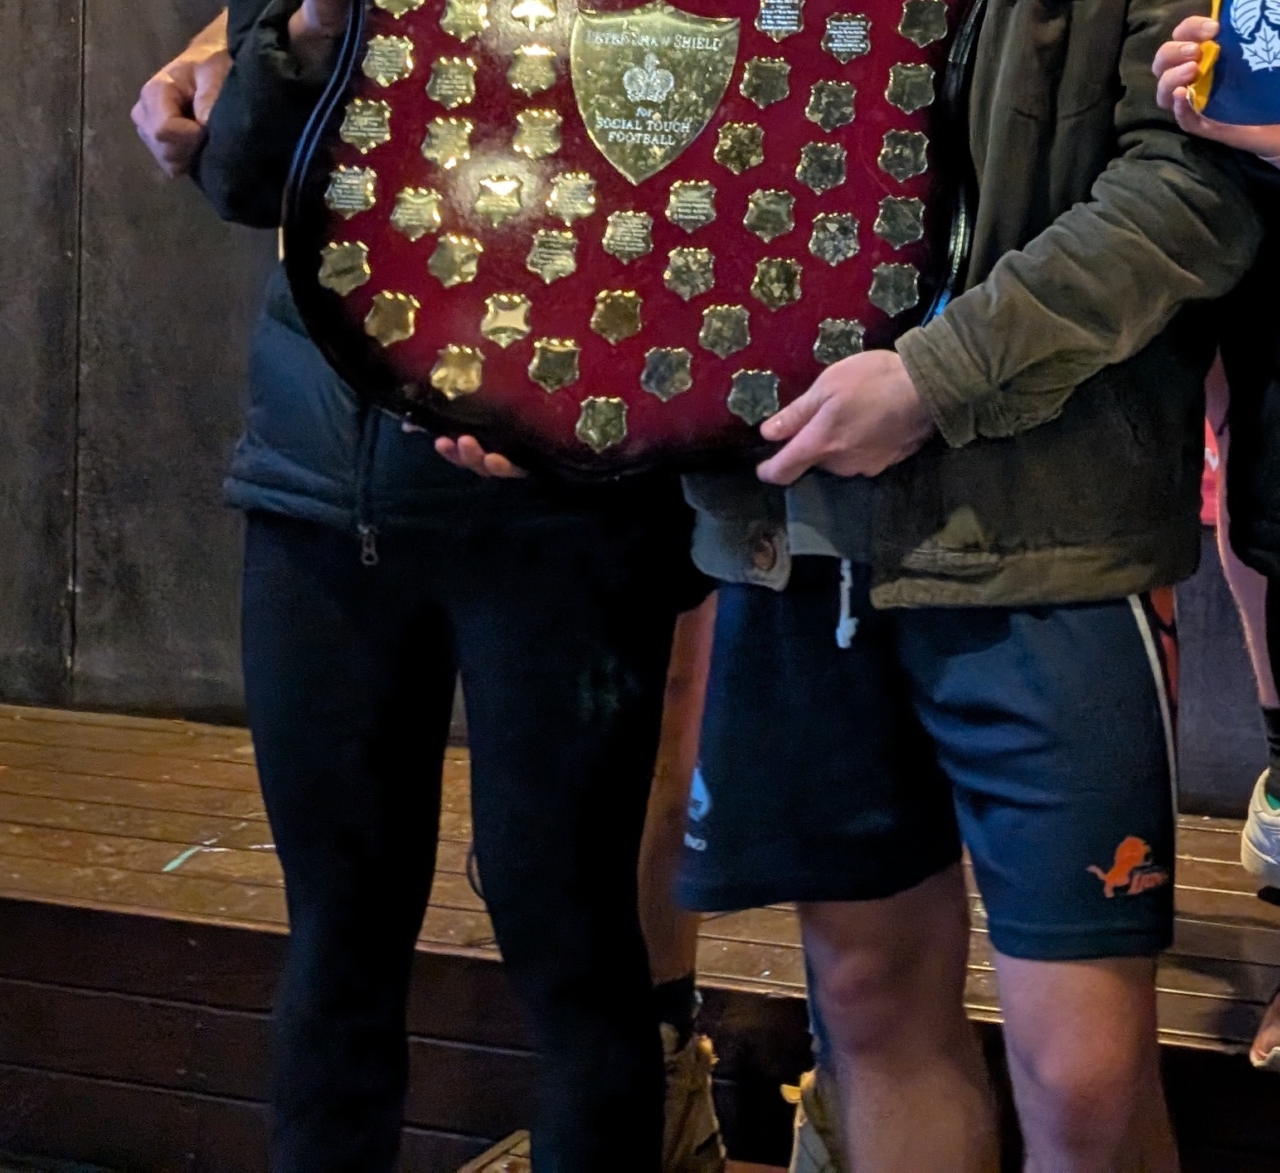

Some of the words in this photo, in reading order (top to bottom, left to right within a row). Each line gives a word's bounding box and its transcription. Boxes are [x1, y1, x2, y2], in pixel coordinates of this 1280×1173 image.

[673, 34, 721, 51] SHIELD
[595, 117, 643, 131] SOCIAL
[645, 119, 691, 134] TOUCH
[607, 131, 677, 146] FOOTBALL
